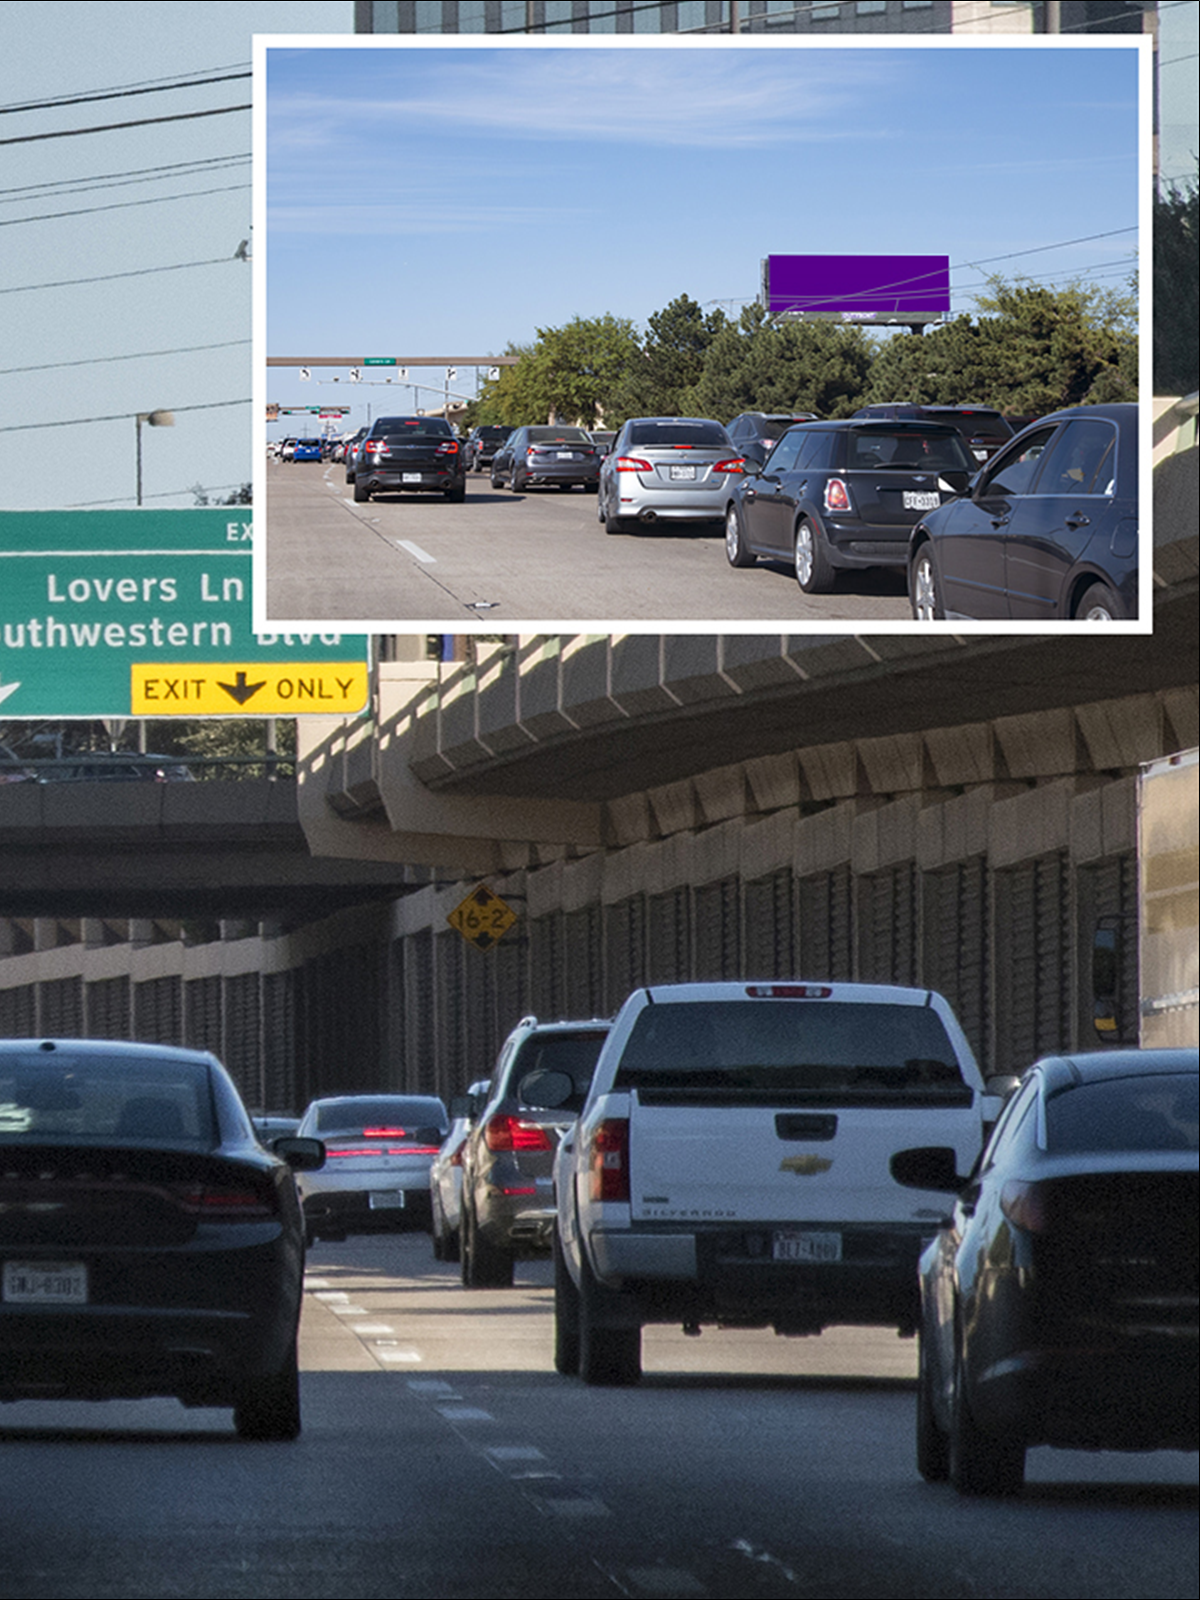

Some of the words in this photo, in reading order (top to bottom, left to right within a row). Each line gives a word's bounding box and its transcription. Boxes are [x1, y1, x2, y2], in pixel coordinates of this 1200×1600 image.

[226, 522, 252, 541] EX
[47, 574, 178, 603] Lovers
[201, 574, 244, 602] Ln
[144, 679, 205, 699] EXIT
[277, 679, 353, 699] ONLY
